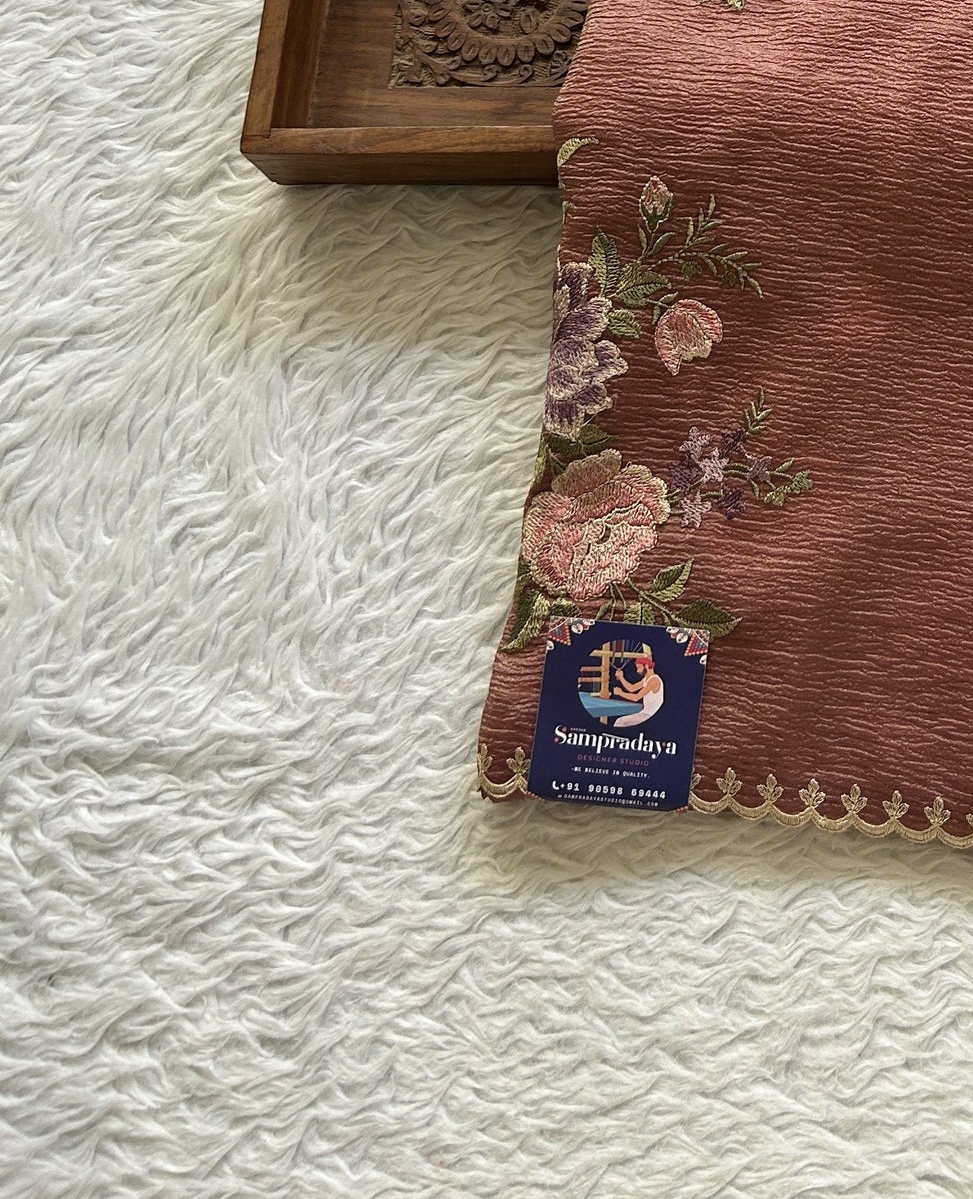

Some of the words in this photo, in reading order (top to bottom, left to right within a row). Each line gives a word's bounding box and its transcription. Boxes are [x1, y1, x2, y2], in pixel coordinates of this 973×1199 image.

[554, 724, 677, 759] Sampradaya
[577, 754, 617, 764] DESIGNER
[620, 756, 649, 767] STUDIO
[584, 767, 609, 775] BELIEVE
[560, 782, 580, 792] +91
[588, 784, 623, 795] 90598
[631, 788, 666, 799] 69444
